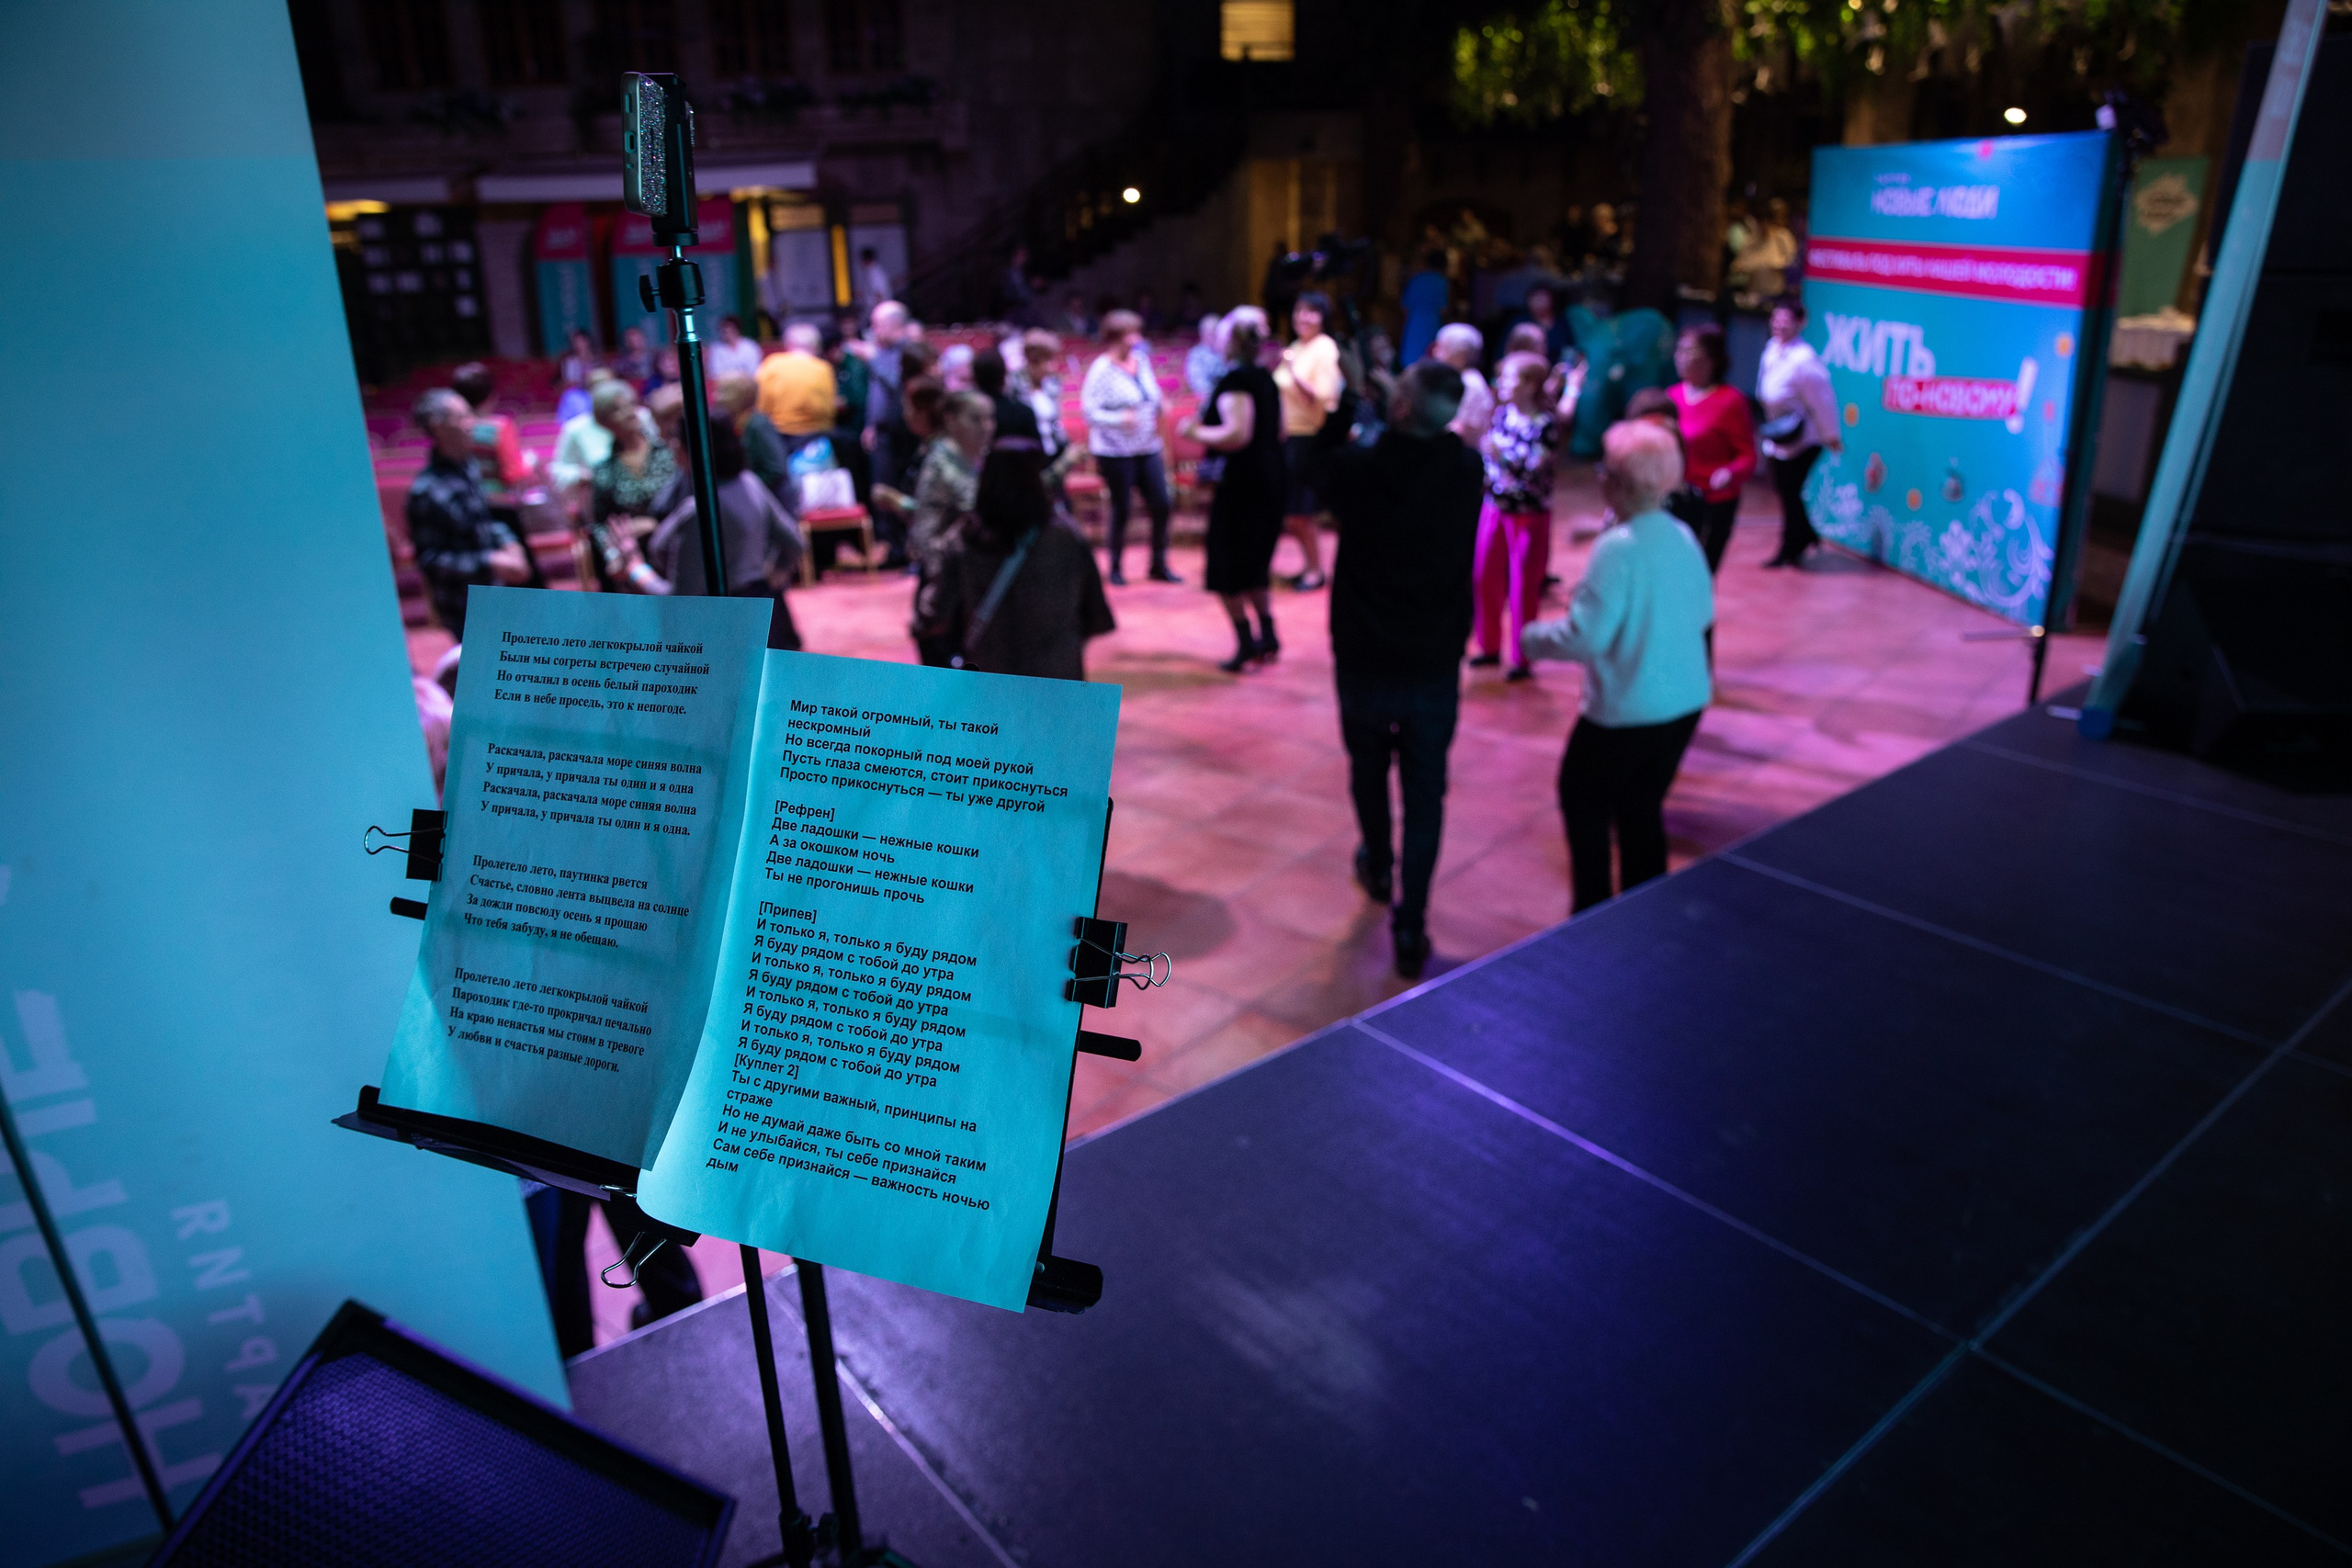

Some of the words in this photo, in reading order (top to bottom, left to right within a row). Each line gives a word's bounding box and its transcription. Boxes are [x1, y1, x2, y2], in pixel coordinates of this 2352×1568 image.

[1822, 311, 1936, 378] ЖИТЬ
[502, 631, 560, 647] Пролетело
[561, 638, 587, 648] лето
[588, 640, 663, 654] легкокрылой
[665, 641, 703, 654] чайкой
[499, 650, 530, 663] Были
[533, 656, 551, 665] мы
[553, 657, 597, 670] согреты
[599, 660, 651, 673] встречею
[653, 662, 710, 676] случайной
[496, 669, 513, 682] Но
[514, 673, 560, 685] отчалил
[562, 677, 569, 686] в
[571, 678, 602, 688] осень
[604, 677, 639, 692] белый
[641, 682, 698, 696] пароходик
[494, 688, 522, 702] Если
[524, 694, 531, 703] в
[533, 693, 557, 705] небе
[559, 696, 605, 710] проседь,
[606, 700, 625, 710] это
[627, 702, 635, 711] к
[637, 703, 687, 716] непогоде.
[790, 699, 818, 716] Мир
[820, 705, 858, 719] такой
[861, 710, 934, 730] огромный,
[938, 719, 957, 731] ты
[960, 722, 999, 736] такой
[787, 718, 871, 738] нескромный
[487, 742, 546, 761] Раскачала,
[548, 751, 604, 765] раскачала
[606, 757, 633, 771] море
[635, 760, 668, 772] синяя
[670, 762, 702, 774] волна
[785, 732, 803, 747] Но
[806, 738, 851, 754] всегда
[854, 744, 923, 761] покорный
[926, 753, 952, 768] под
[955, 757, 990, 771] моей
[993, 761, 1034, 775] рукой
[779, 766, 828, 784] Просто
[831, 775, 925, 797] прикоснуться
[945, 791, 965, 803] ты
[967, 794, 994, 807] уже
[995, 797, 1046, 813] другой
[782, 750, 821, 766] Пусть
[825, 758, 861, 772] глаза
[864, 762, 926, 782] смеются,
[931, 772, 970, 785] стоит
[972, 776, 1069, 797] прикоснуться
[774, 799, 835, 823] [Рефрен]
[769, 833, 779, 846] А
[782, 838, 797, 849] за
[800, 840, 859, 858] окошком
[862, 850, 895, 863] ночь
[771, 817, 797, 832] Две
[799, 823, 859, 840] ладошки
[879, 835, 933, 852] нежные
[936, 843, 979, 858] кошки
[472, 854, 528, 873] Пролетело
[529, 865, 557, 879] лето,
[559, 869, 610, 885] паутинка
[611, 876, 648, 890] рвется
[764, 866, 785, 882] Ты
[787, 874, 803, 885] не
[806, 876, 880, 897] прогонишь
[883, 888, 925, 904] прочь
[467, 893, 479, 906] За
[479, 898, 514, 911] дожди
[514, 903, 561, 921] повсюду
[562, 910, 593, 923] осень
[594, 915, 602, 925] я
[604, 917, 648, 931] прощаю
[469, 874, 514, 893] Счастье,
[516, 883, 554, 897] словно
[555, 889, 586, 902] лента
[588, 894, 635, 909] выцвела
[638, 901, 650, 911] на
[652, 903, 690, 917] солнце
[758, 900, 818, 925] [Припев]
[753, 934, 764, 947] Я
[766, 937, 798, 956] буду
[800, 945, 844, 962] рядом
[847, 953, 855, 964] с
[858, 955, 899, 971] тобой
[900, 963, 920, 976] до
[922, 966, 955, 982] утра
[756, 918, 767, 931] И
[769, 922, 815, 939] только
[818, 931, 830, 943] я,
[833, 933, 881, 950] только
[883, 942, 892, 953] я
[895, 942, 929, 961] буду
[931, 950, 978, 967] рядом
[452, 987, 511, 1008] Пароходик
[512, 1000, 545, 1014] где-то
[547, 1007, 603, 1026] прокричал
[605, 1018, 652, 1036] печально
[447, 1025, 457, 1037] У
[457, 1031, 492, 1045] любви
[494, 1037, 503, 1047] и
[503, 1039, 545, 1055] счастья
[546, 1048, 583, 1064] разные
[582, 1056, 620, 1073] дороги.
[449, 1006, 464, 1020] На
[466, 1012, 495, 1025] краю
[496, 1018, 546, 1035] ненастья
[547, 1027, 565, 1039] мы
[566, 1032, 596, 1046] стоим
[597, 1038, 605, 1047] в
[606, 1040, 645, 1056] тревоге
[733, 1053, 785, 1074] [Куплет
[786, 1064, 799, 1080] 2]
[726, 1089, 773, 1108] страже
[731, 1069, 751, 1085] Ты
[753, 1077, 762, 1088] с
[763, 1079, 820, 1100] другими
[822, 1091, 880, 1115] важный,
[884, 1104, 956, 1128] принципы
[960, 1120, 977, 1133] на
[718, 1120, 729, 1134] И
[730, 1126, 747, 1138] не
[748, 1130, 820, 1157] улыбайся,
[825, 1146, 843, 1160] ты
[846, 1152, 879, 1168] себе
[882, 1159, 956, 1185] признайся
[722, 1103, 741, 1119] Но
[743, 1111, 760, 1122] не
[761, 1115, 805, 1133] думай
[806, 1124, 842, 1141] даже
[844, 1130, 880, 1149] быть
[884, 1141, 901, 1154] со
[904, 1145, 941, 1162] мной
[944, 1154, 987, 1172] таким
[705, 1157, 739, 1173] дым
[713, 1137, 741, 1155] Сам
[743, 1147, 775, 1163] себе
[778, 1155, 851, 1179] признайся
[871, 1176, 938, 1200] важность
[942, 1191, 990, 1211] ночью
